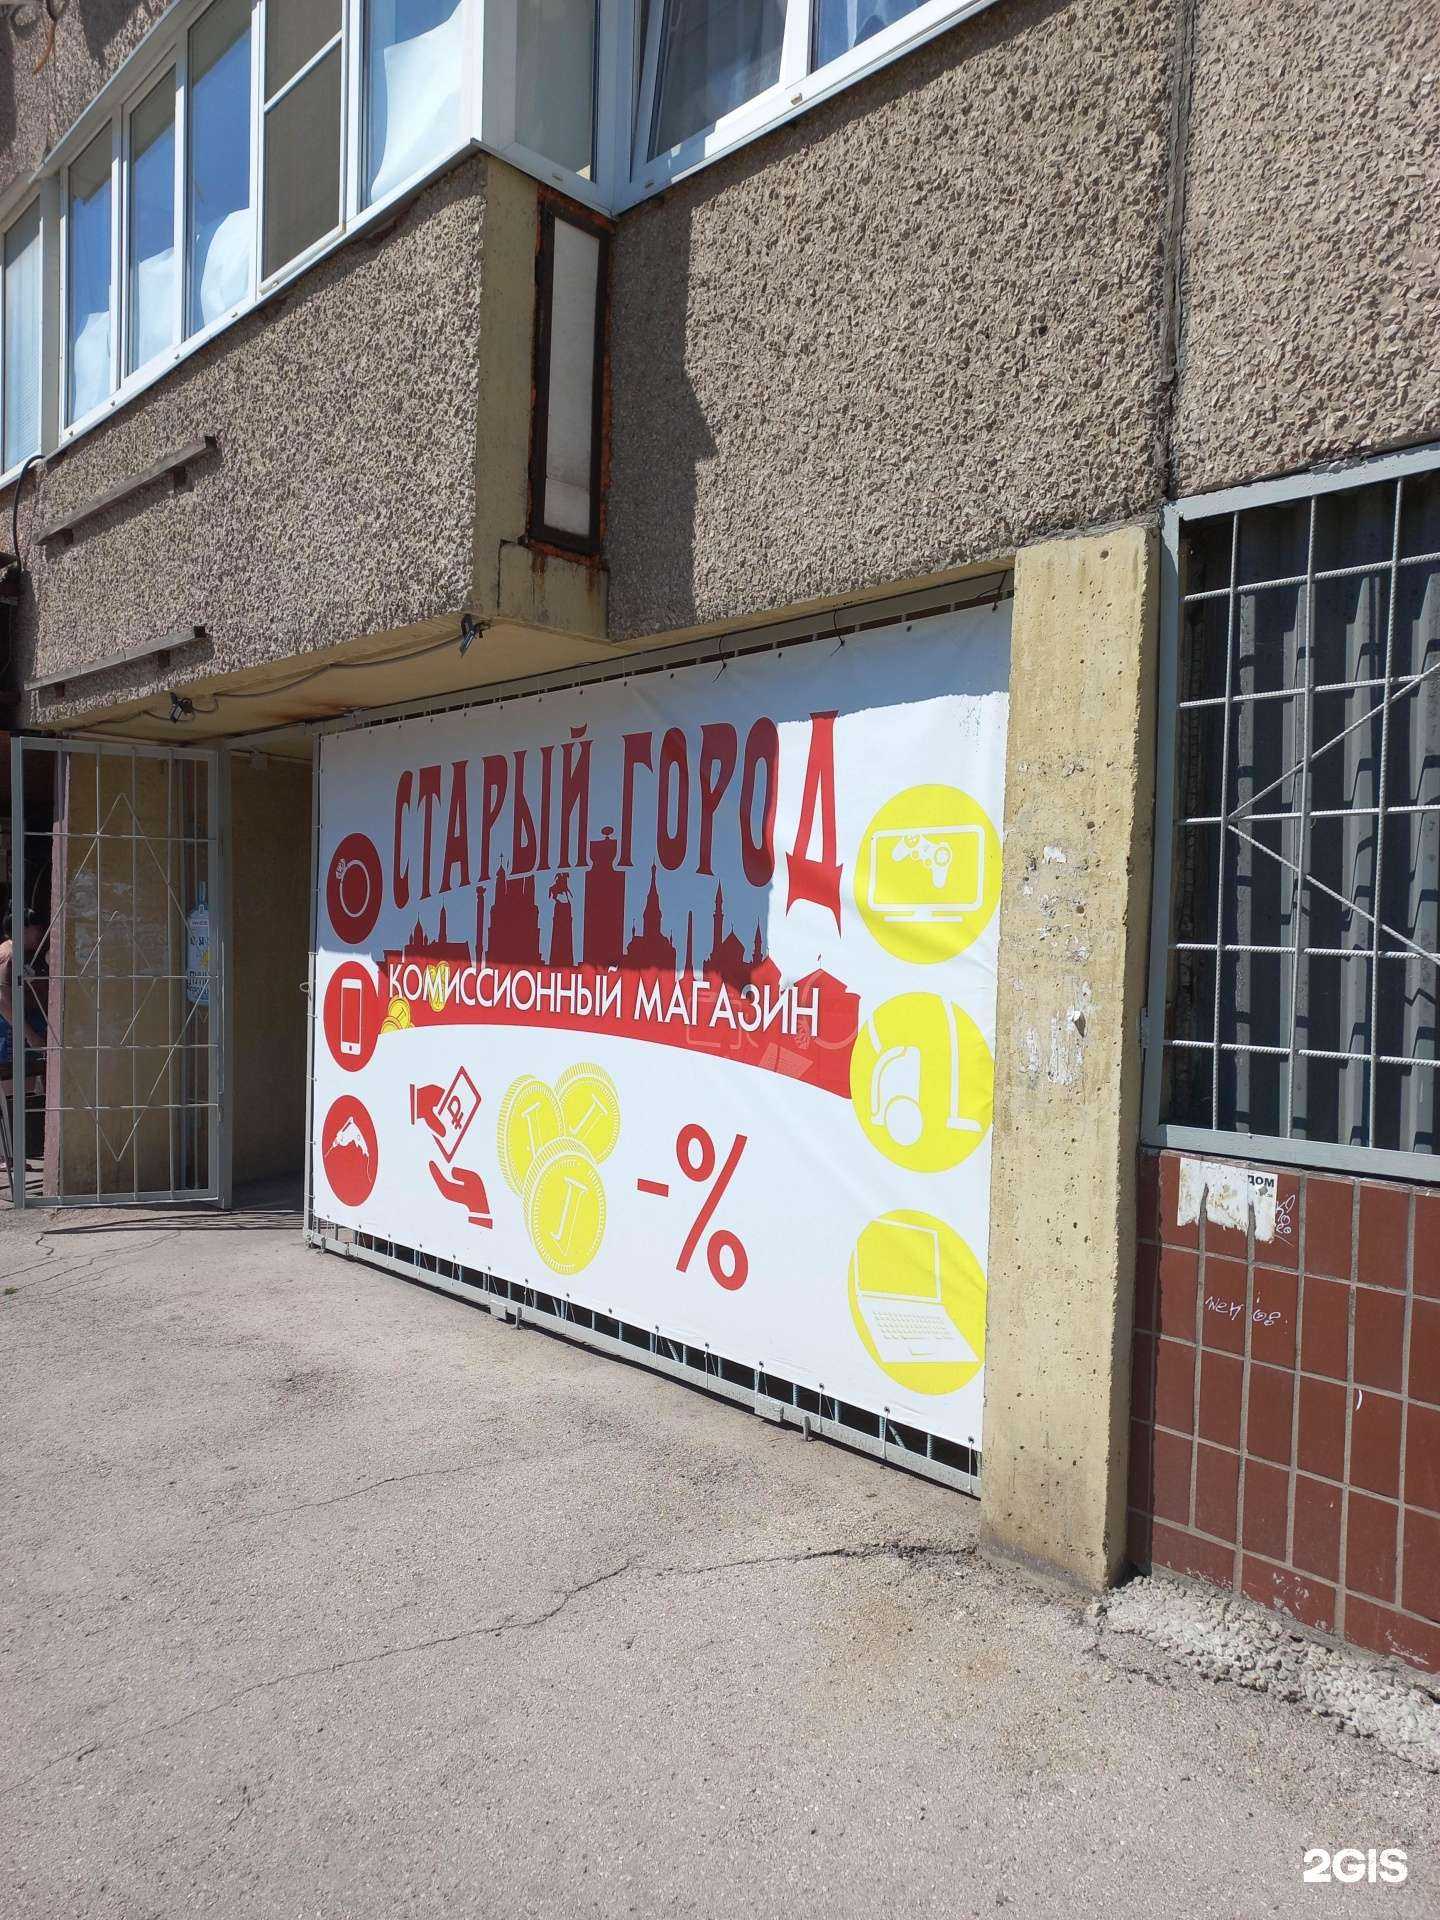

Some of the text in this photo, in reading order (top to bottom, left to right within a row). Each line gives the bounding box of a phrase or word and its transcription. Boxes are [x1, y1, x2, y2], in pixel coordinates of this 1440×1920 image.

[393, 710, 843, 938] СТАРЫЙ ГОРОД
[388, 963, 820, 1037] КОМИССИОННЫЙ МАГАЗИН
